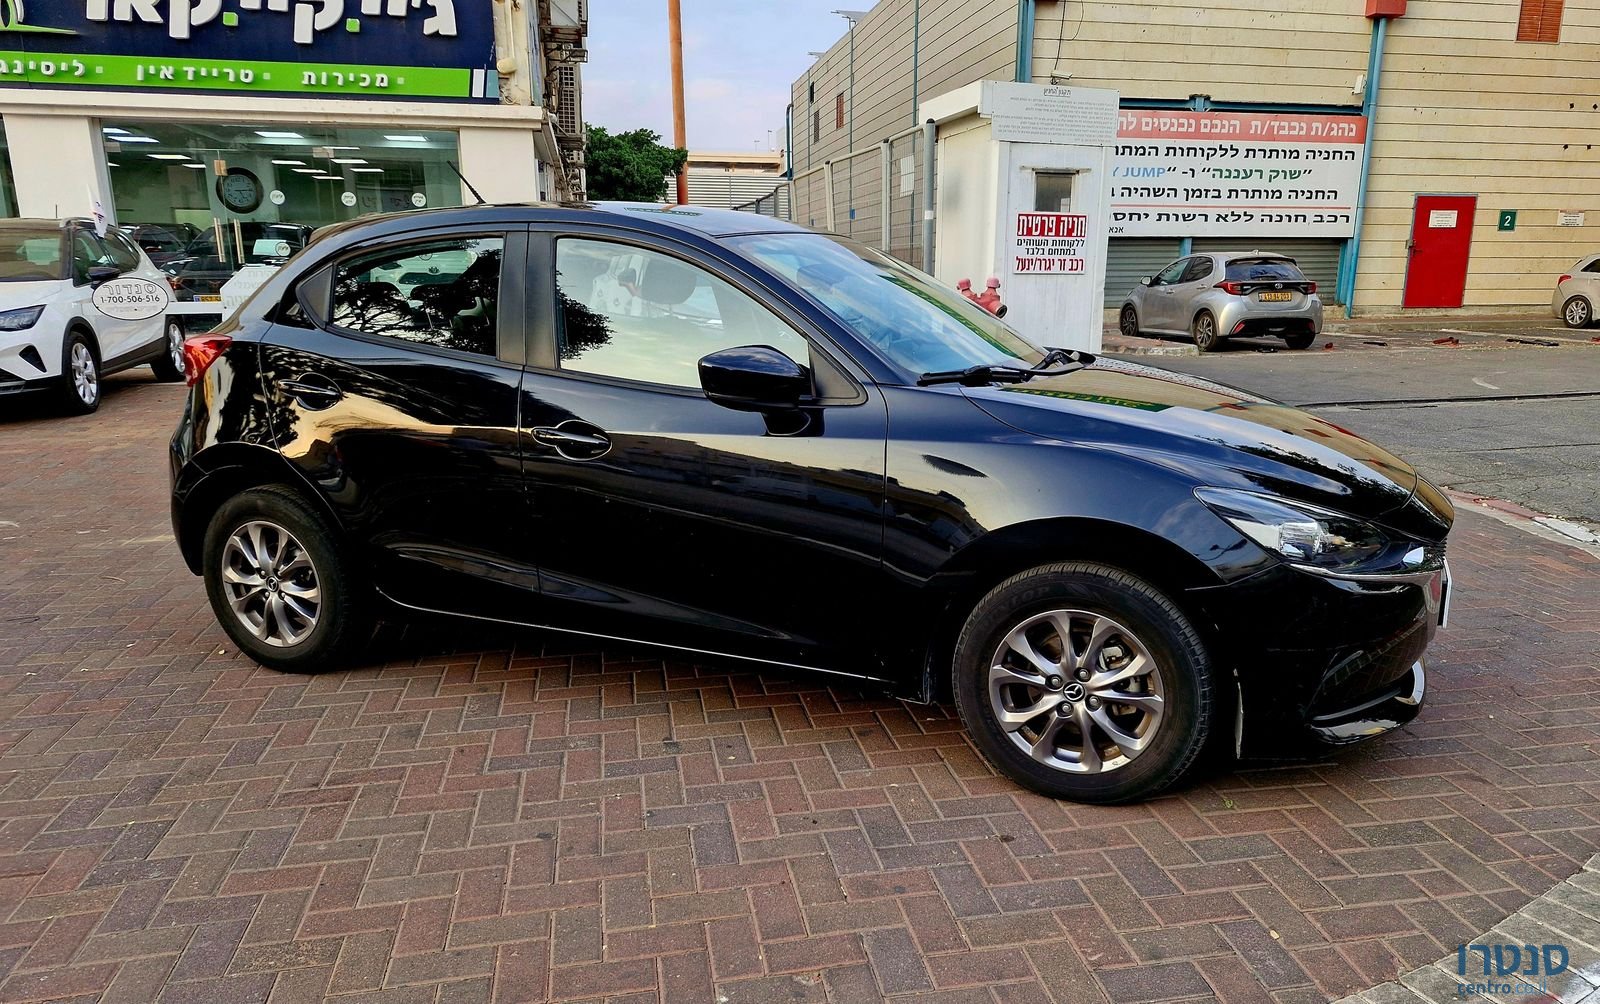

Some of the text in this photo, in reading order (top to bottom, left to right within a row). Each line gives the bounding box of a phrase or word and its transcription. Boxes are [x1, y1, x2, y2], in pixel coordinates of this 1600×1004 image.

[137, 64, 255, 83] טרייד אין
[302, 70, 389, 87] מכירות
[1141, 116, 1196, 132] נכנסים
[1200, 118, 1240, 134] הנכם
[1249, 119, 1307, 136] נכבד/ת
[1310, 121, 1357, 137] נהג/ת
[1164, 144, 1239, 161] ללקוחות
[1243, 147, 1300, 160] מותרת
[1305, 149, 1355, 161] החניה
[1120, 186, 1178, 198] השהיה
[1183, 187, 1222, 202] בזמן
[1226, 188, 1283, 200] מותרת
[1287, 189, 1338, 200] החניה
[1110, 210, 1350, 223] רכב חונה ללא רשות יחס
[1503, 215, 1512, 227] 2
[1018, 215, 1086, 237] חניה פרטית
[1108, 226, 1124, 234] אנא
[1016, 238, 1085, 249] ללקוחות השוהים
[1025, 246, 1076, 256] במתחם בלבד
[1015, 255, 1084, 272] רכב זר יגרר/ינעל
[102, 283, 157, 295] סנדור
[100, 294, 160, 304] 1-700-506-516
